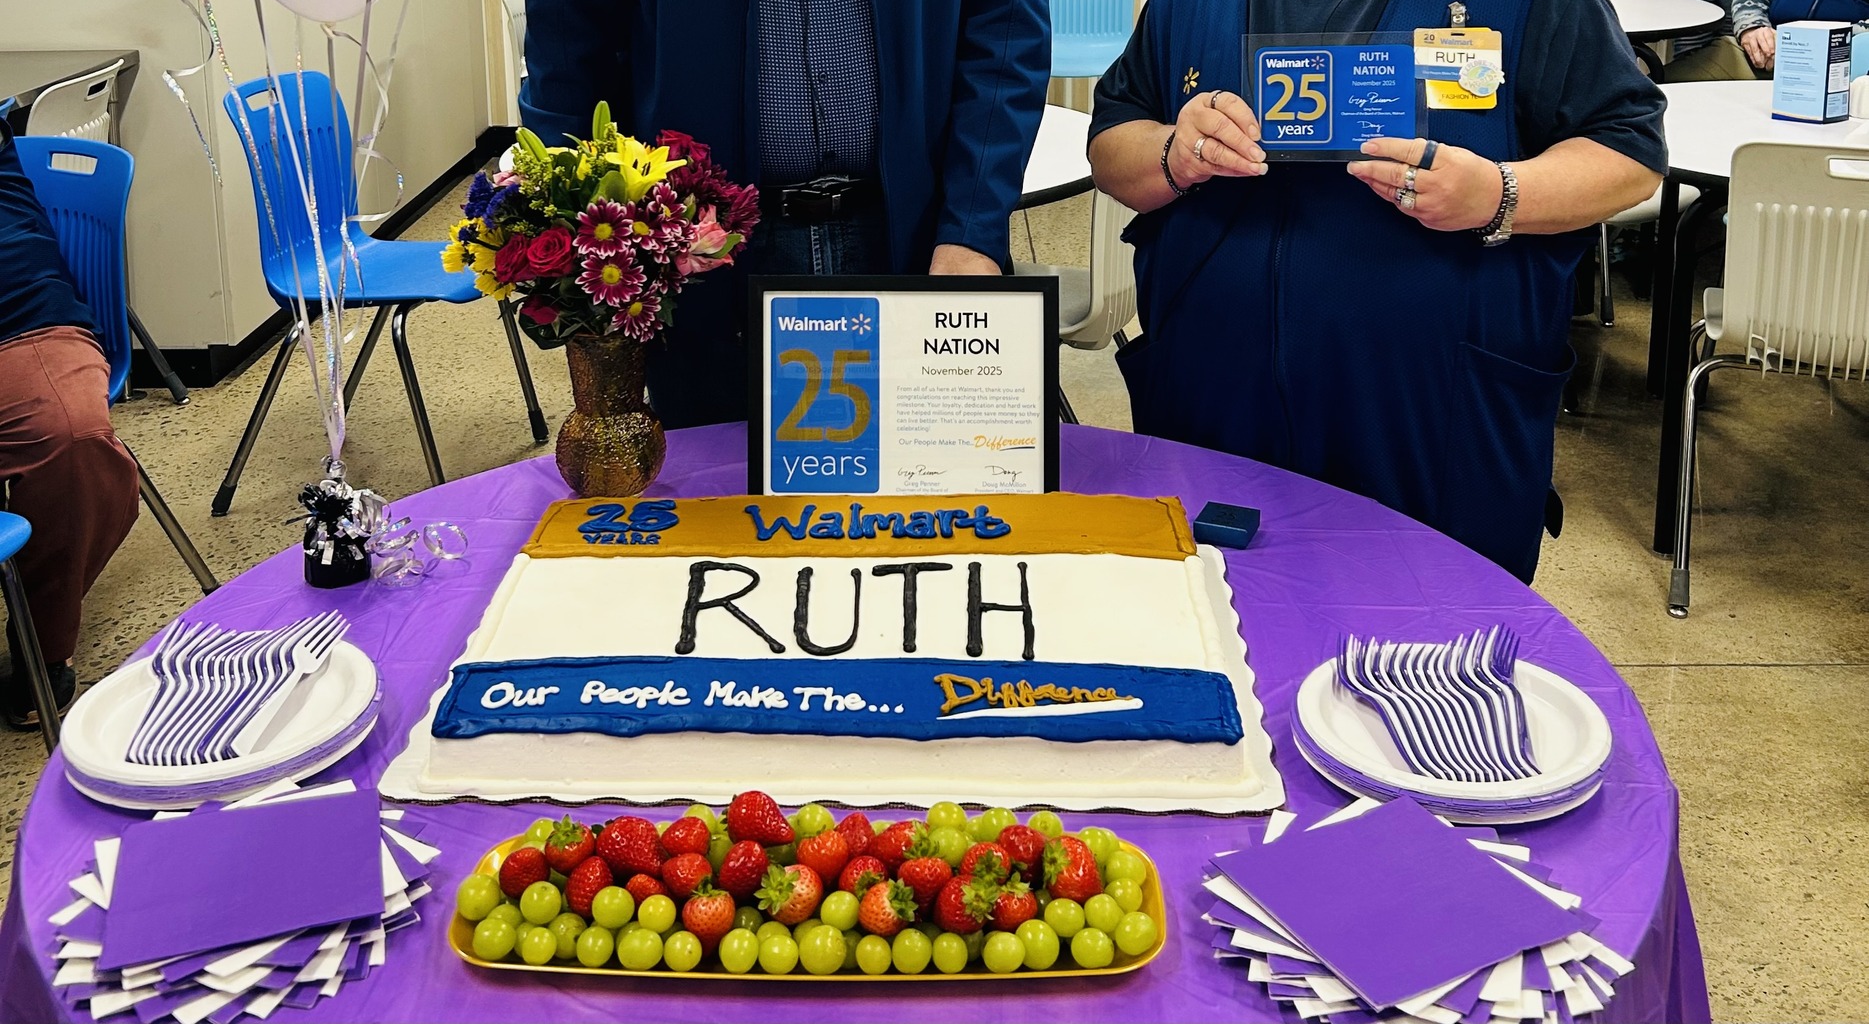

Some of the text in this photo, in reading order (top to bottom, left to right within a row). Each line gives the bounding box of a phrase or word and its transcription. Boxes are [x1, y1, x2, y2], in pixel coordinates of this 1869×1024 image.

[1440, 38, 1473, 46] Walmart
[1265, 58, 1310, 69] Walmart
[1359, 51, 1389, 62] RUTH
[1435, 51, 1476, 64] RUTH
[1353, 65, 1395, 76] NATION
[1264, 73, 1327, 122] 25
[1277, 123, 1314, 138] years
[778, 316, 847, 332] Walmart
[935, 312, 988, 329] RUTH
[923, 338, 1000, 355] NATION
[921, 365, 1003, 376] November 2025
[775, 348, 871, 443] 25
[951, 394, 976, 402] reaching
[989, 394, 1019, 402] impressive
[898, 438, 913, 446] Our
[914, 438, 937, 447] People
[939, 438, 956, 446] Make
[974, 435, 1037, 451] Difference
[782, 455, 868, 485] years
[745, 502, 1012, 541] Walmart
[582, 532, 662, 545] YEARS
[673, 560, 1036, 662] RUTH
[480, 681, 559, 709] Our
[580, 680, 691, 709] People
[704, 680, 789, 710] Make
[793, 685, 905, 713] The...
